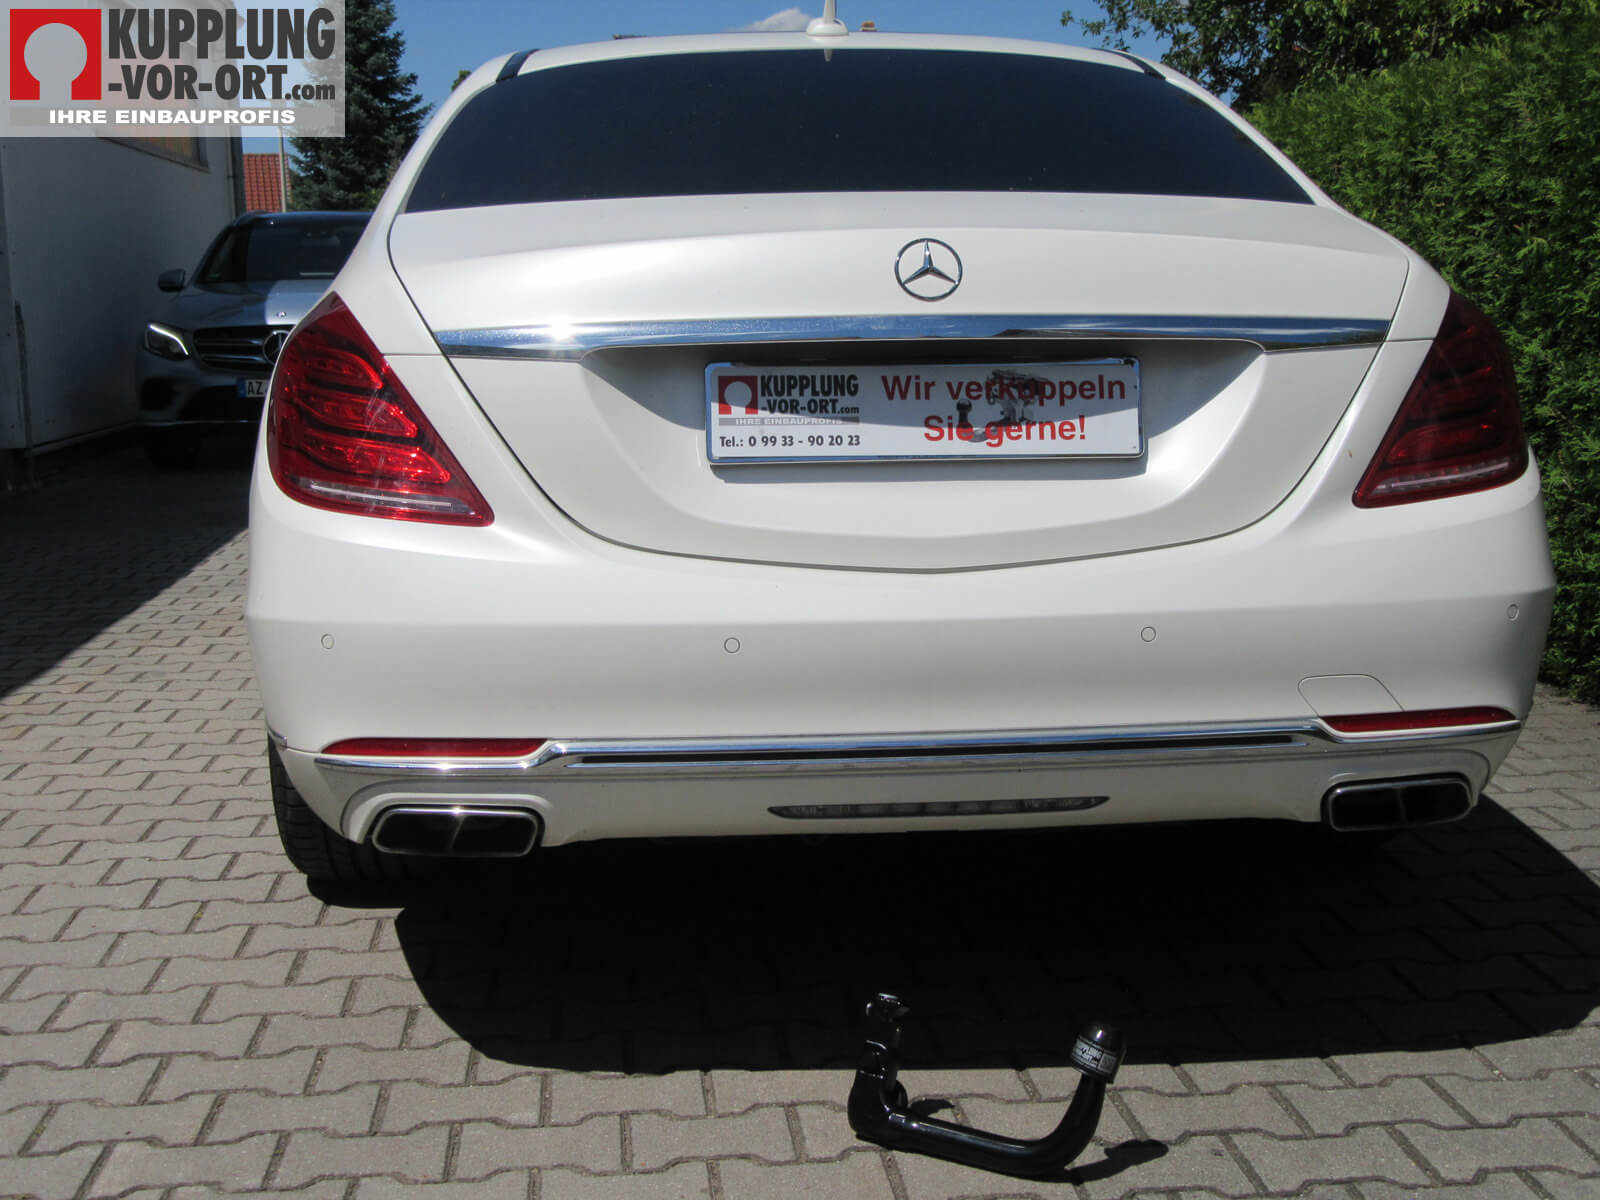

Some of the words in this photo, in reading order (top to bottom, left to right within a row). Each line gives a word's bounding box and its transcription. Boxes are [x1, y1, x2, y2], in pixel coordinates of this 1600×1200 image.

[247, 381, 264, 395] AZ
[760, 374, 859, 397] KUPPLUNG
[881, 375, 936, 401] Wir
[760, 398, 860, 414] -VOR-ORT.com
[923, 415, 974, 442] Sie
[984, 415, 1086, 448] gerne!
[720, 436, 744, 447] Tel.:
